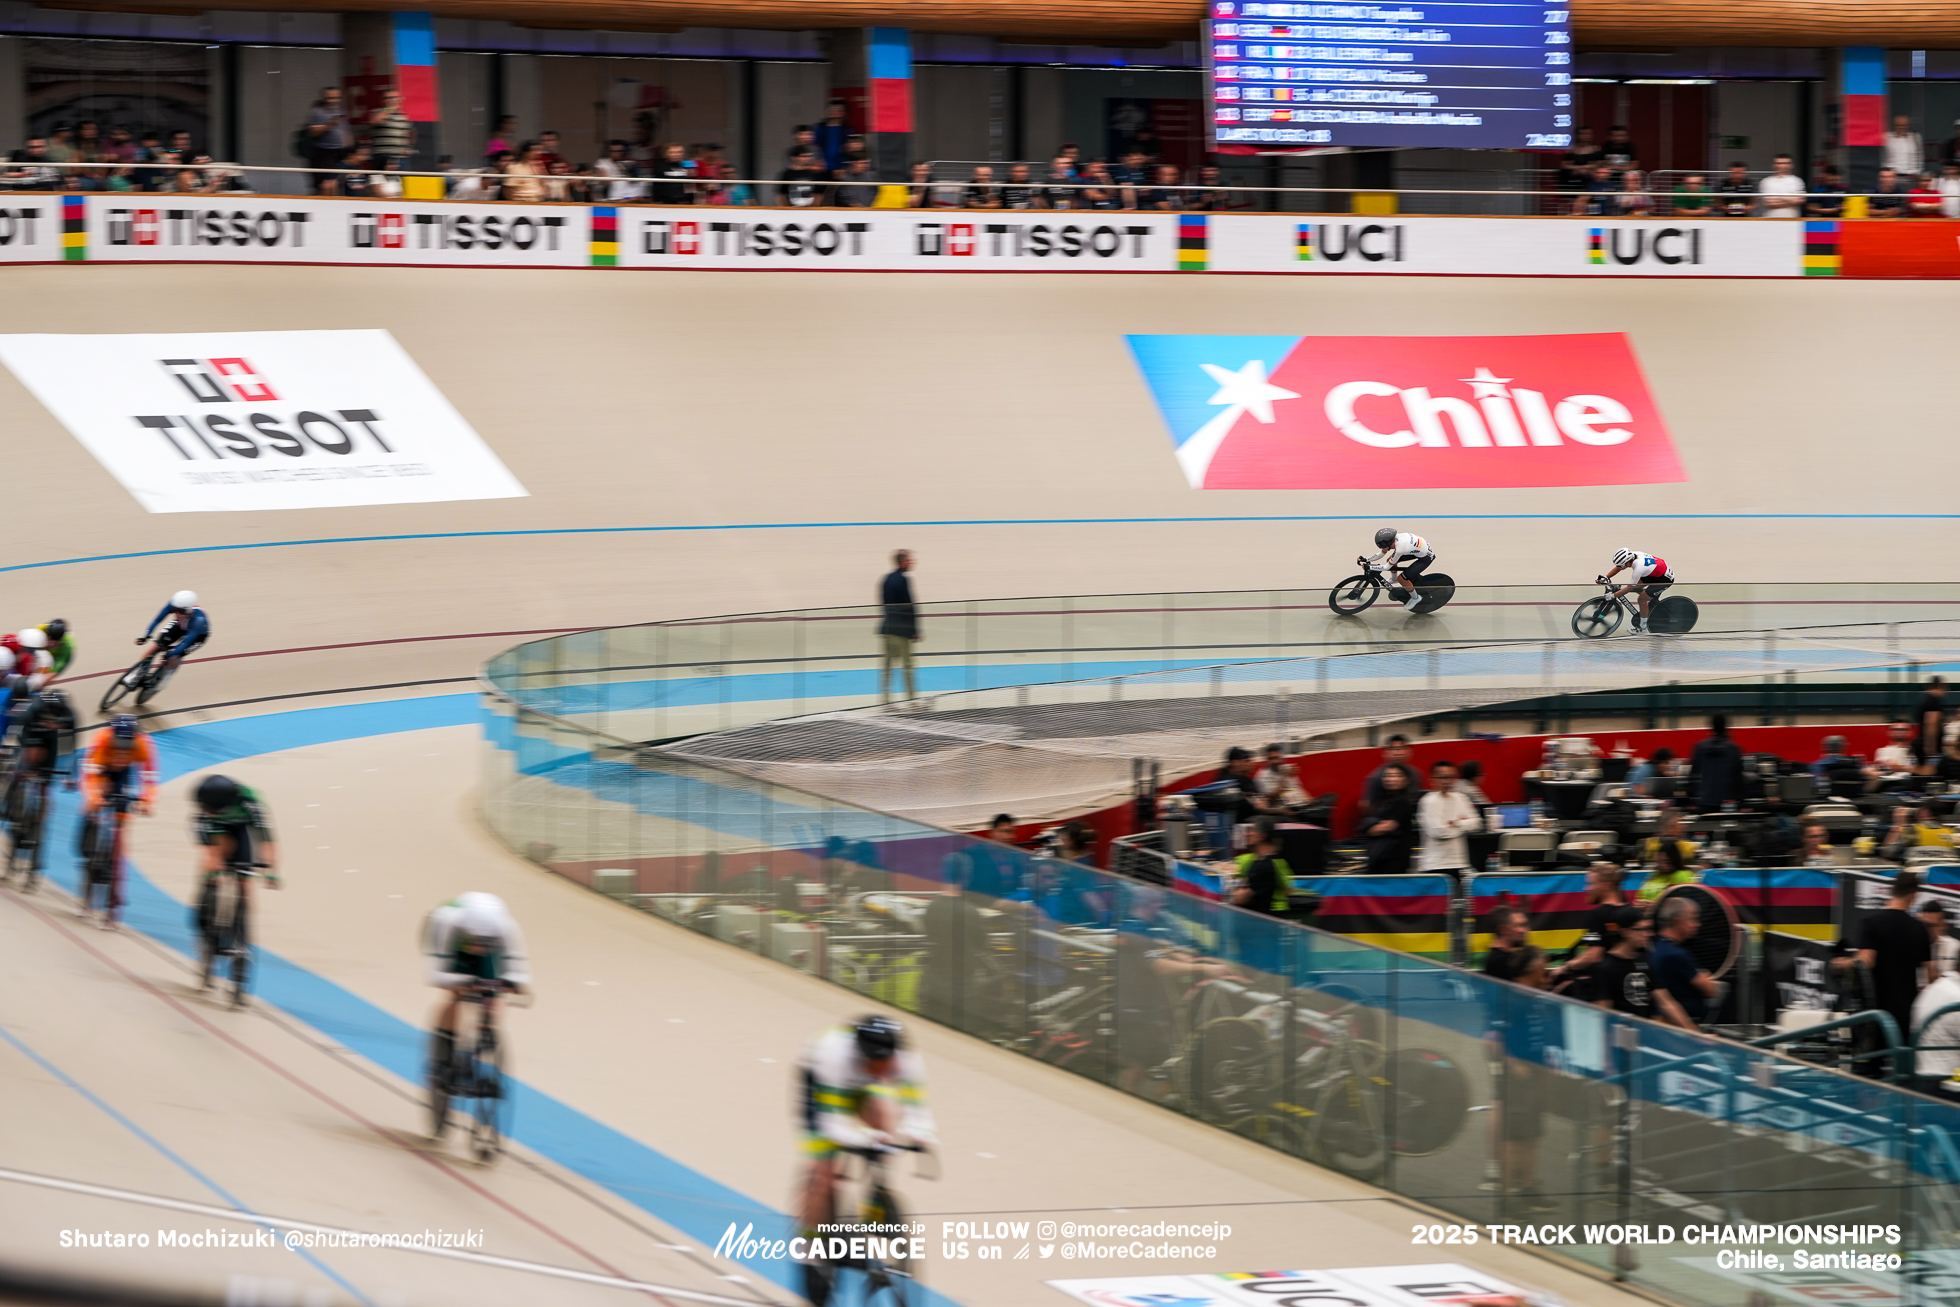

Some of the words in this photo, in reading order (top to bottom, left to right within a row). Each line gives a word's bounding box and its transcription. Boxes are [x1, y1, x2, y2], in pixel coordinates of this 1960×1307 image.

[165, 209, 311, 247] TISSOT
[412, 215, 567, 250] TISSOT
[709, 222, 870, 256] TISSOT
[985, 224, 1152, 258] TISSOT
[1318, 224, 1404, 262] UCI
[1609, 228, 1702, 265] UCI
[1324, 367, 1634, 448] Chile
[134, 409, 394, 460] TISSOT
